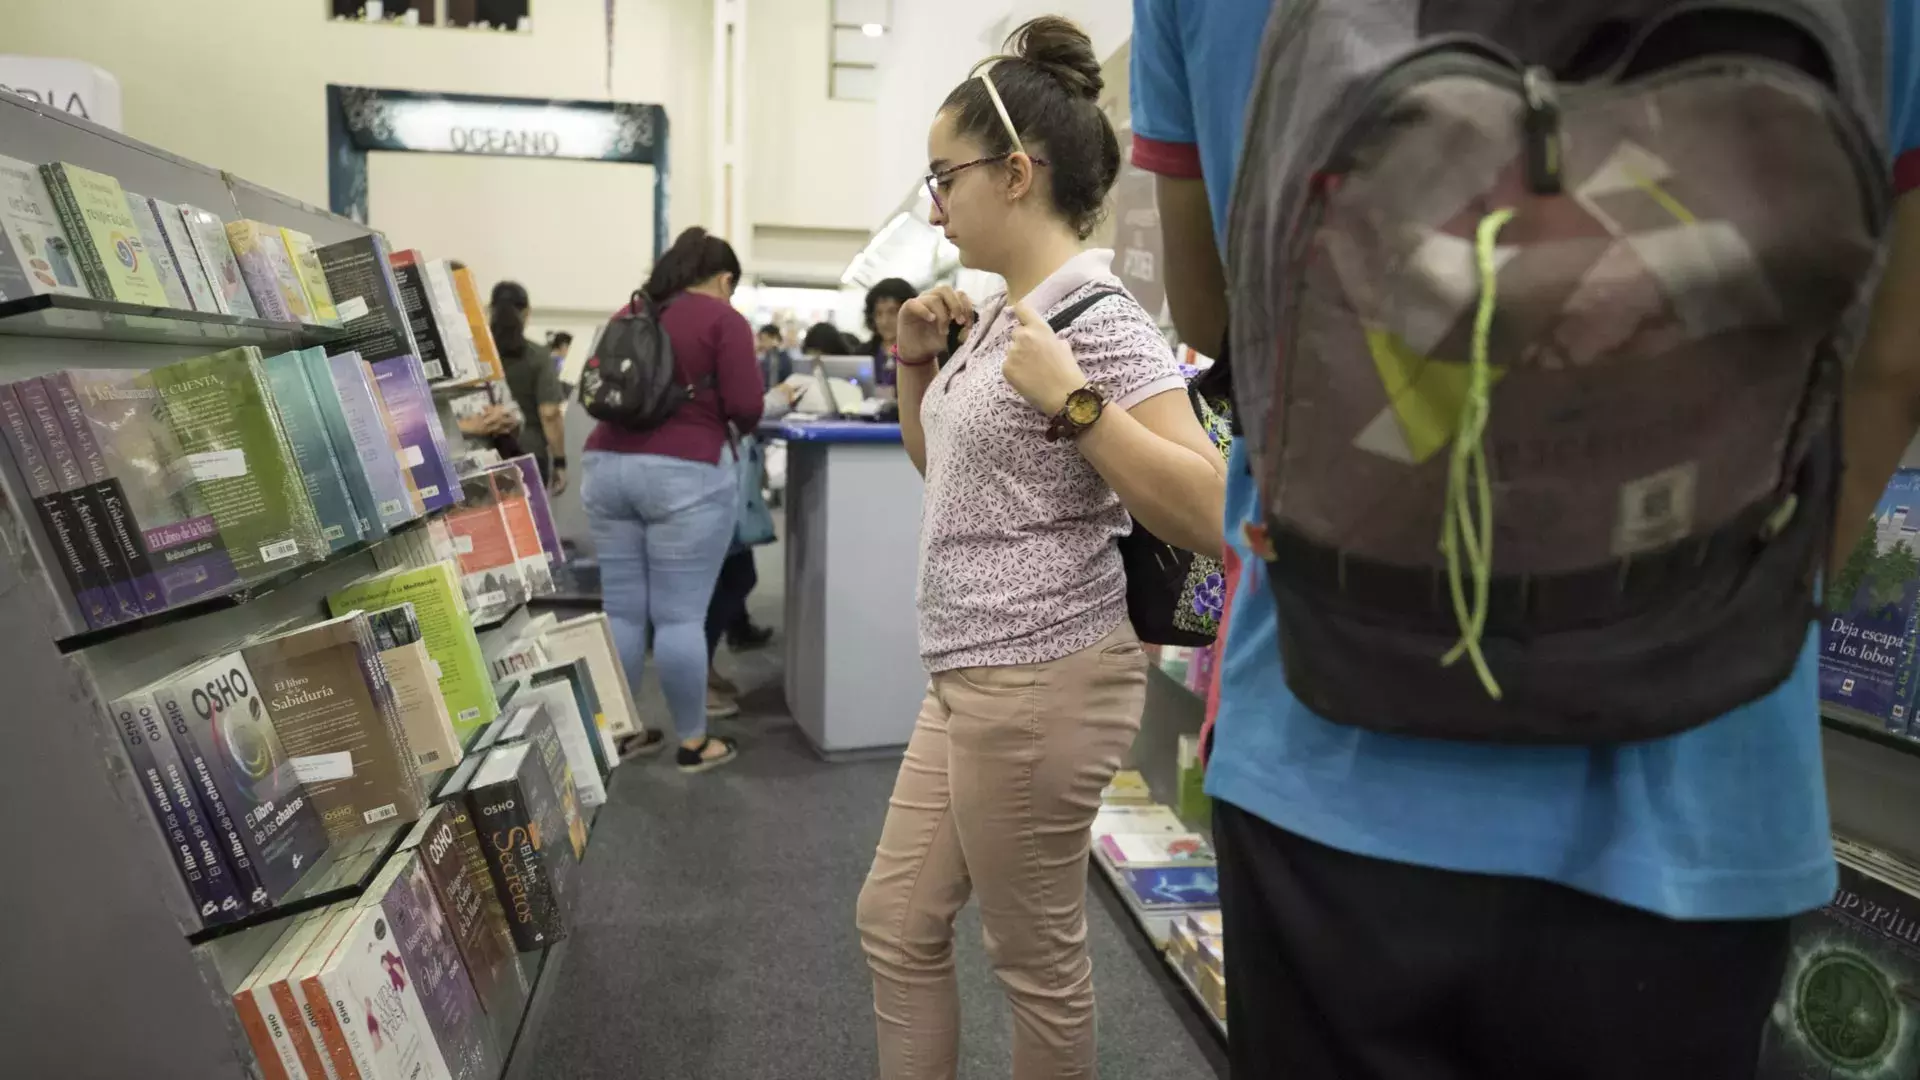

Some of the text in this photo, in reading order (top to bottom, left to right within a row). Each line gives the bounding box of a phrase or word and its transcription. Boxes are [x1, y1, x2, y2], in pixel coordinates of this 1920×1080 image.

[449, 126, 561, 156] OCEANO
[31, 466, 50, 491] Vida
[59, 459, 80, 485] Vida
[86, 452, 105, 477] Vida
[51, 511, 88, 572] Krishnamurti
[76, 506, 114, 567] Krishnamurti
[103, 497, 140, 558] Krishnamurti
[1831, 617, 1905, 649] Deja escapa
[1828, 638, 1896, 667] a los lobos
[191, 668, 249, 720] OSHO
[271, 685, 334, 712] Sabiduría
[274, 675, 309, 692] El libro
[120, 710, 141, 745] OSHO
[139, 707, 161, 742] OSHO
[166, 700, 187, 735] OSHO
[167, 764, 222, 877] El libro de los chakras
[194, 756, 250, 870] El libro de los chakras
[244, 801, 274, 830] El libro
[254, 797, 304, 845] de los chakras
[325, 807, 353, 821] OSHO
[482, 799, 515, 816] OSHO
[147, 768, 202, 882] El libro de los chakras
[429, 823, 453, 865] OSHO
[493, 826, 533, 925] Secretos
[519, 844, 537, 884] El Libro
[268, 1013, 283, 1038] OSHO
[303, 1003, 319, 1027] OSHO
[336, 1000, 351, 1024] OSHO
